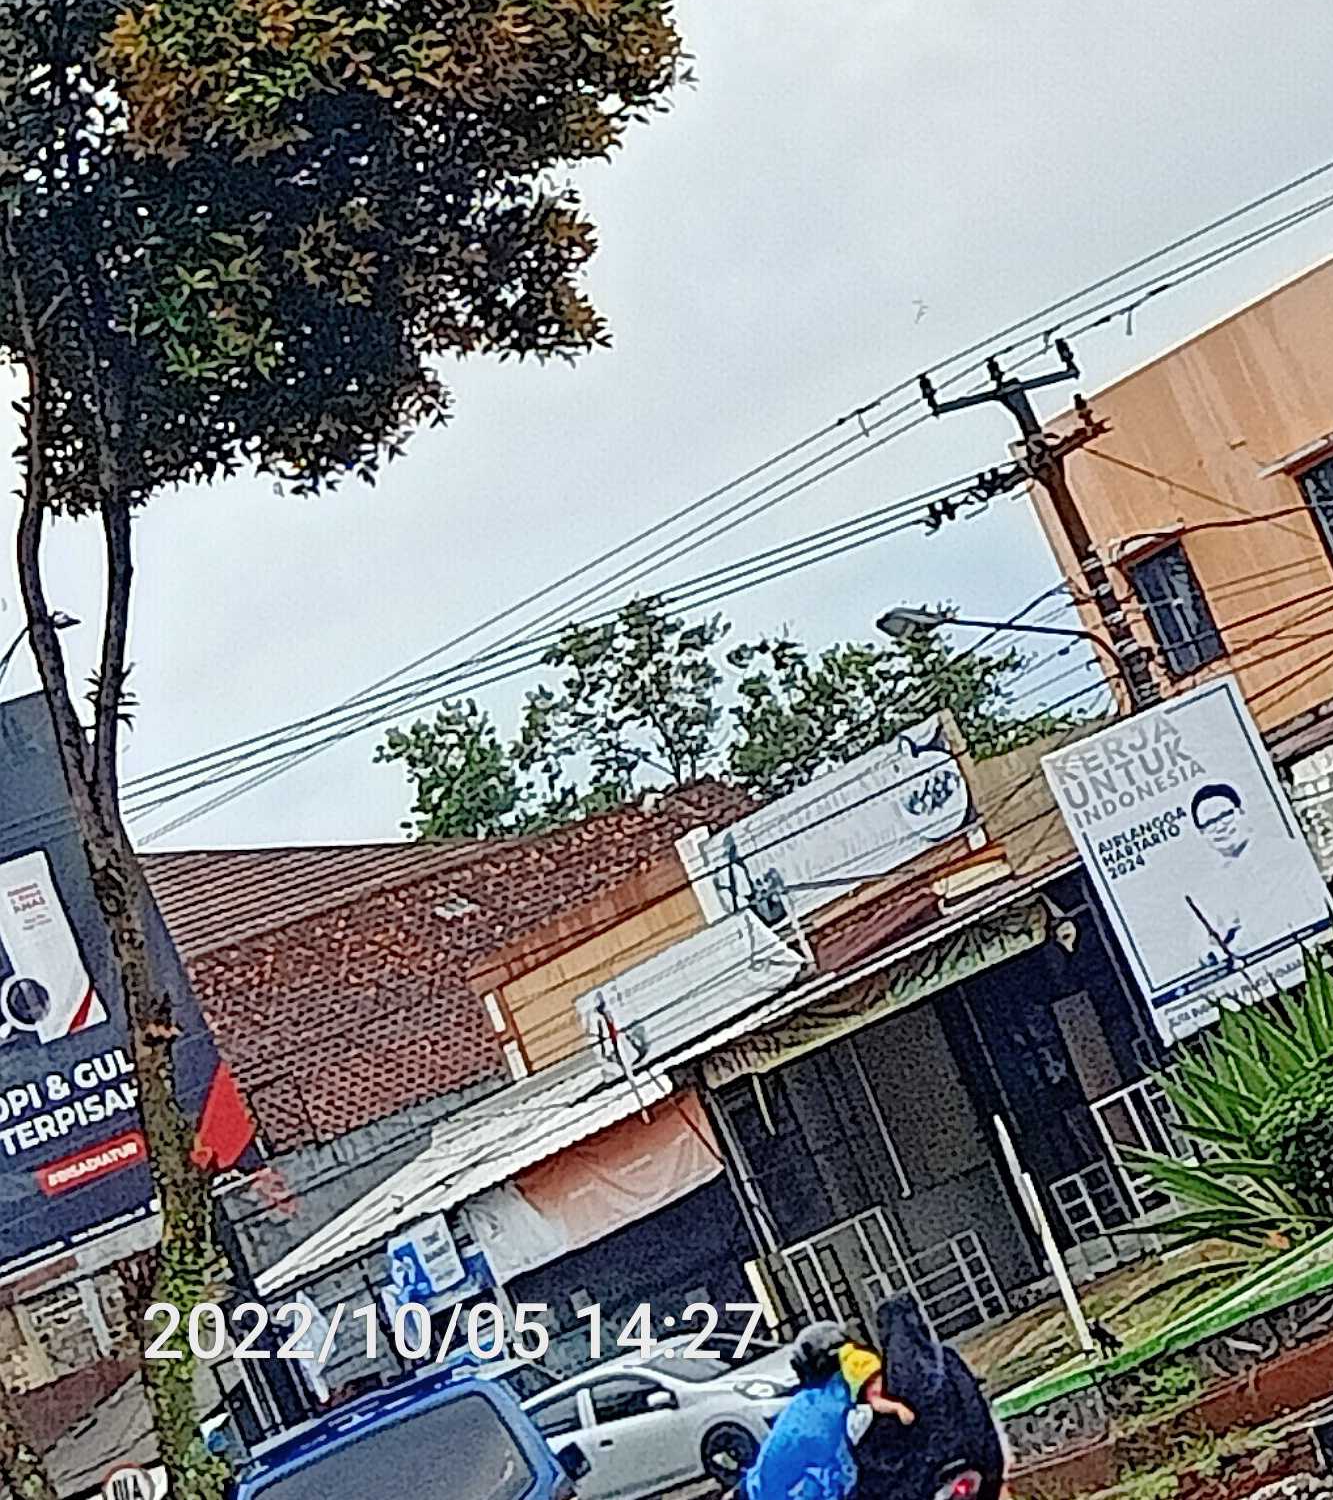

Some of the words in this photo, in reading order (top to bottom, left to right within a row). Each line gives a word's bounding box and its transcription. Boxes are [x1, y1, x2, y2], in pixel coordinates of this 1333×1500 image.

[1053, 712, 1179, 786] KERJA
[1062, 736, 1193, 811] UNTUK
[1072, 759, 1207, 830] INDONESIA
[1107, 854, 1146, 881] 2024
[46, 1072, 71, 1102] &
